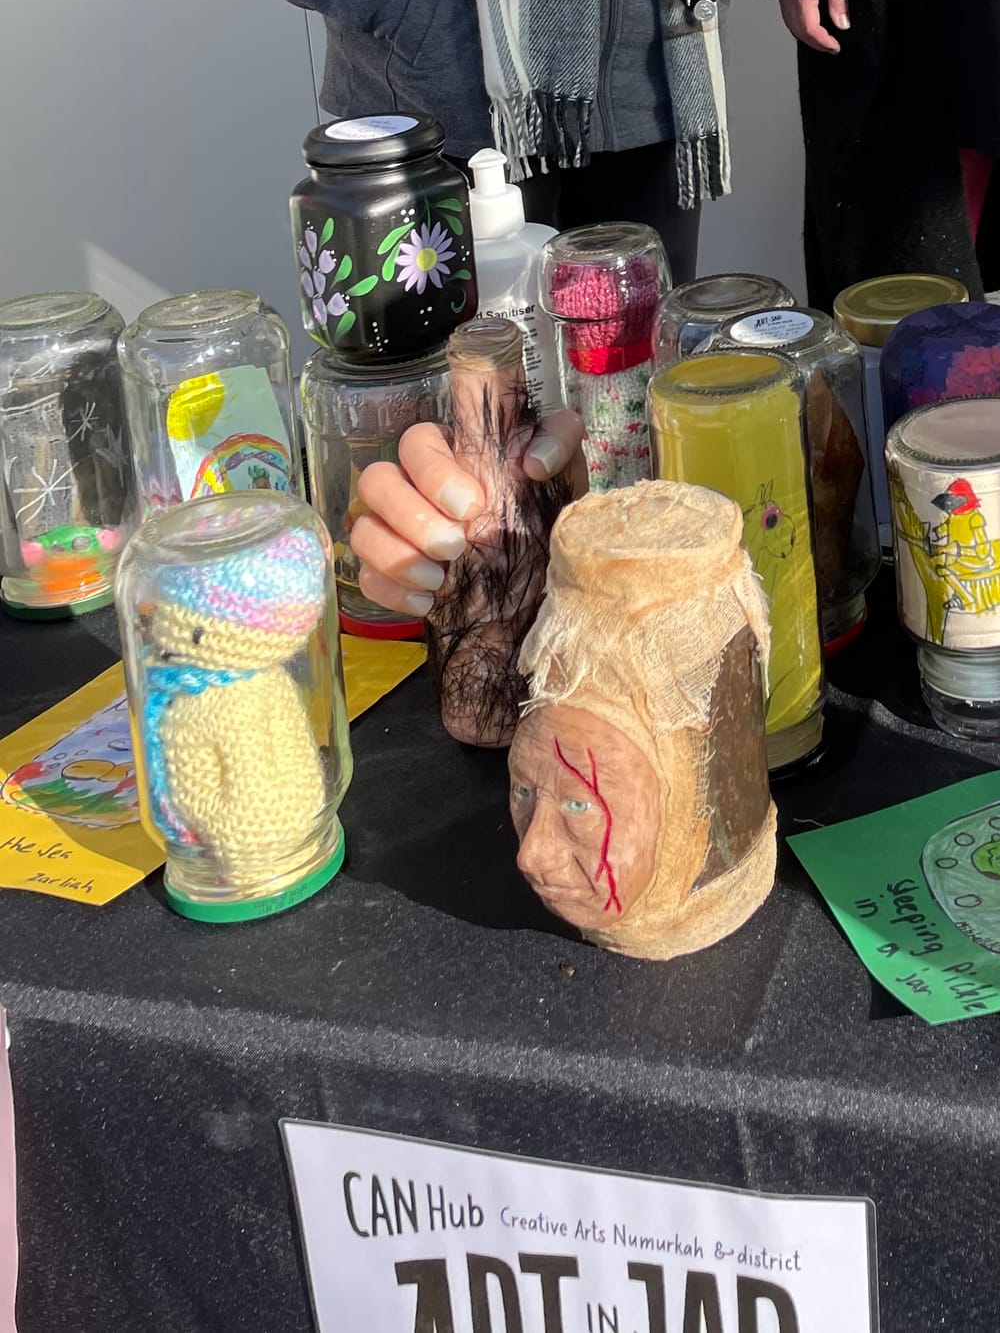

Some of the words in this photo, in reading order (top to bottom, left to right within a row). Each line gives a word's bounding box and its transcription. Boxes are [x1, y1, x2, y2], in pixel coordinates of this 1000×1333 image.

[486, 304, 536, 319] Sanitiser
[855, 894, 885, 918] in
[877, 942, 900, 958] a
[896, 967, 932, 996] jar
[342, 1171, 419, 1238] CAN
[427, 1182, 485, 1232] Hub
[500, 1206, 568, 1237] Creative
[574, 1219, 606, 1245] Arts
[613, 1223, 704, 1259] Numurkah
[714, 1241, 735, 1259] &
[737, 1245, 802, 1272] district
